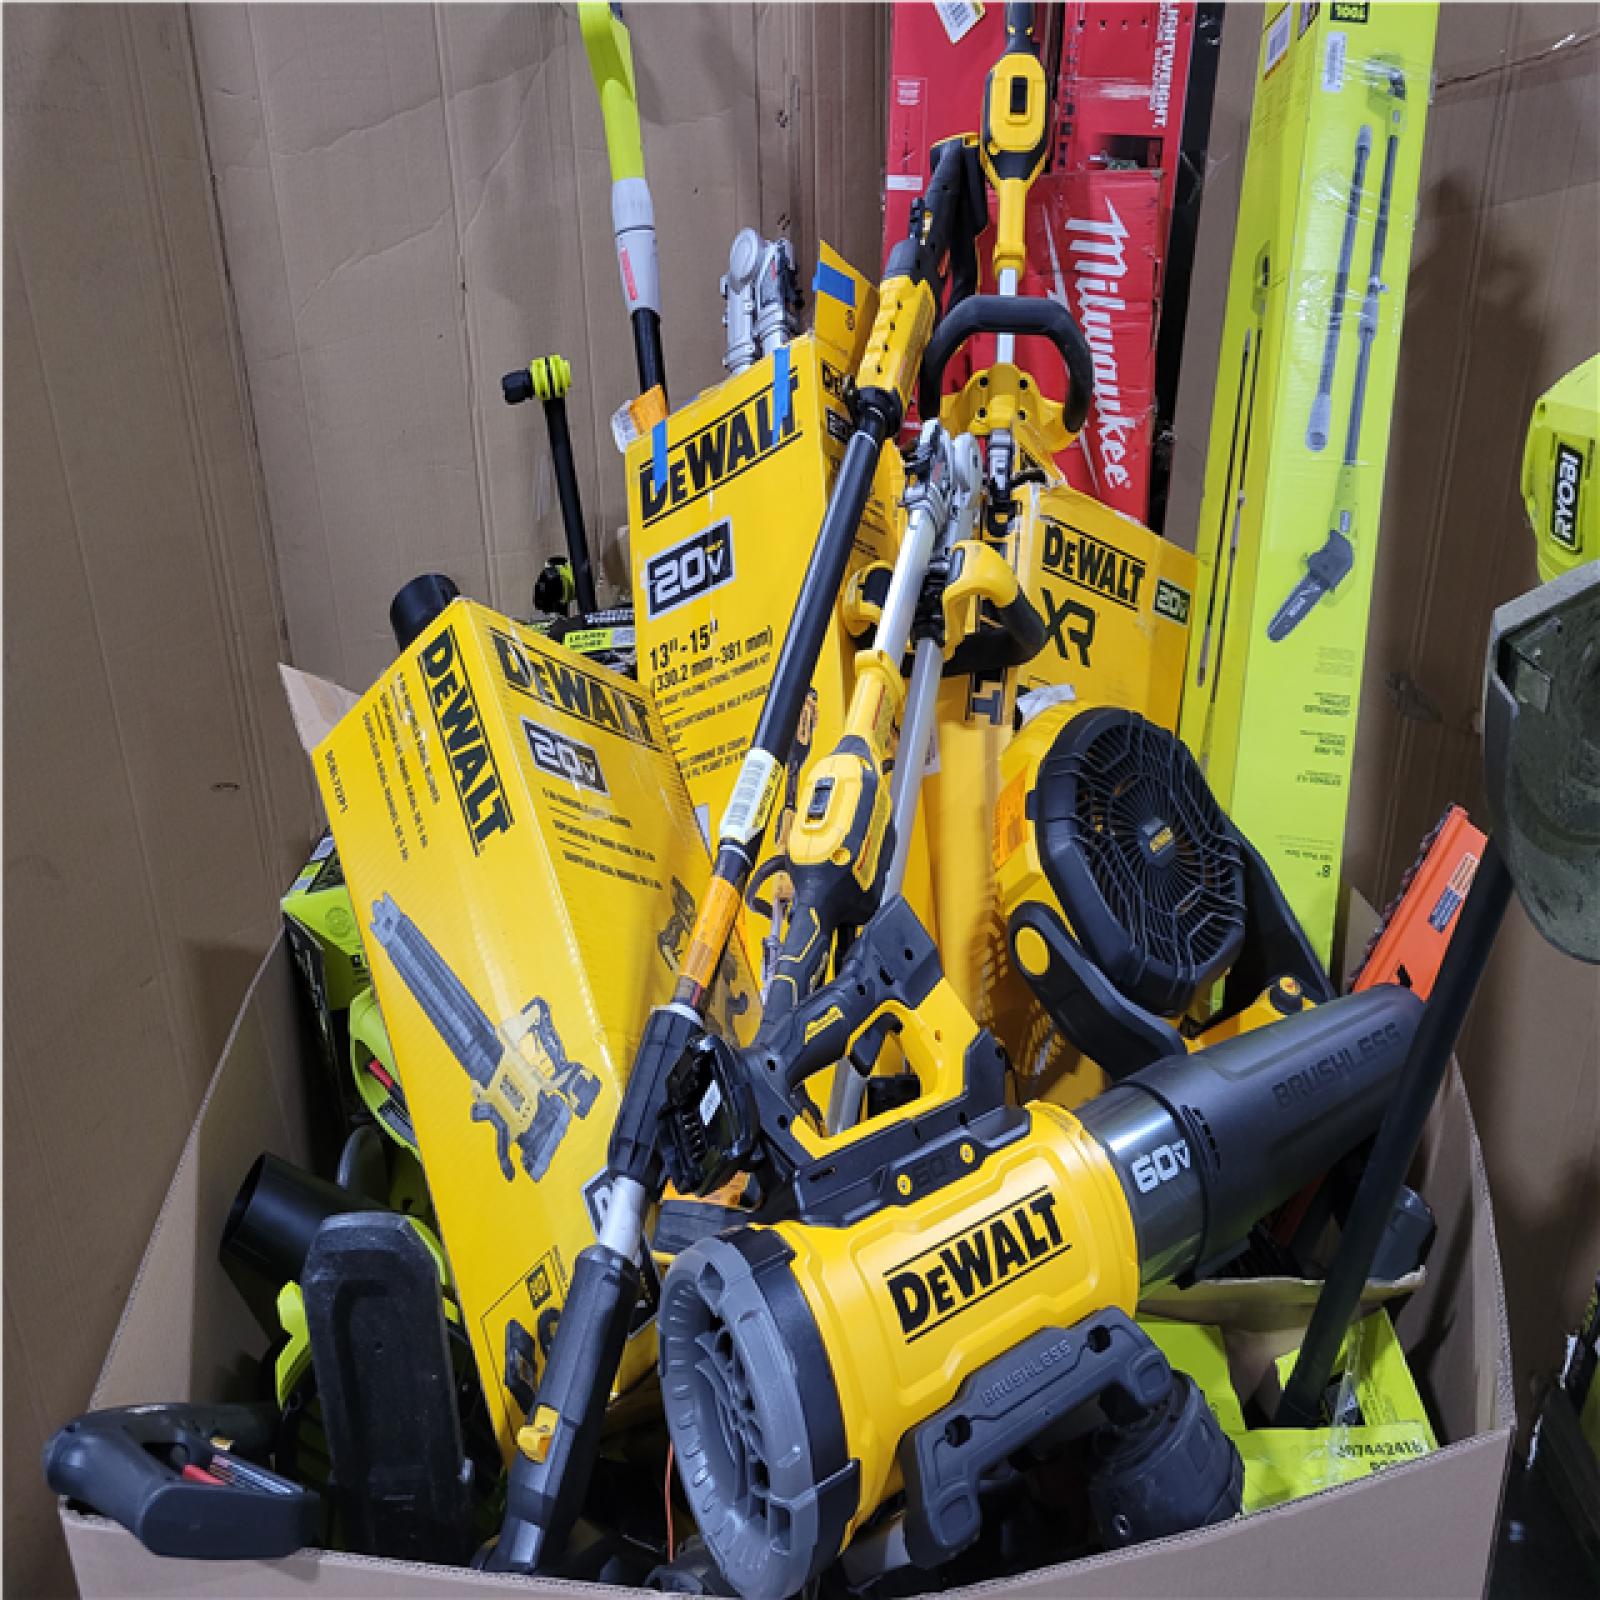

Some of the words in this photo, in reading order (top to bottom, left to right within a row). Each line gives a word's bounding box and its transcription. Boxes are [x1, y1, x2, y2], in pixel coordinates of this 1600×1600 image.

[1065, 195, 1136, 489] Milwaukee
[640, 374, 799, 521] DEWALT
[1554, 451, 1580, 539] RYOBI
[653, 540, 725, 603] 20V
[1042, 524, 1146, 603] DEWALT
[1040, 586, 1096, 668] XR
[493, 634, 656, 745] DEWALT
[420, 628, 511, 843] DEWALT
[1271, 1022, 1401, 1107] BRUSHLESS
[1131, 1140, 1191, 1194] 60V
[886, 1192, 1064, 1335] DEWALT
[981, 1338, 1072, 1408] BRUSHLESS
